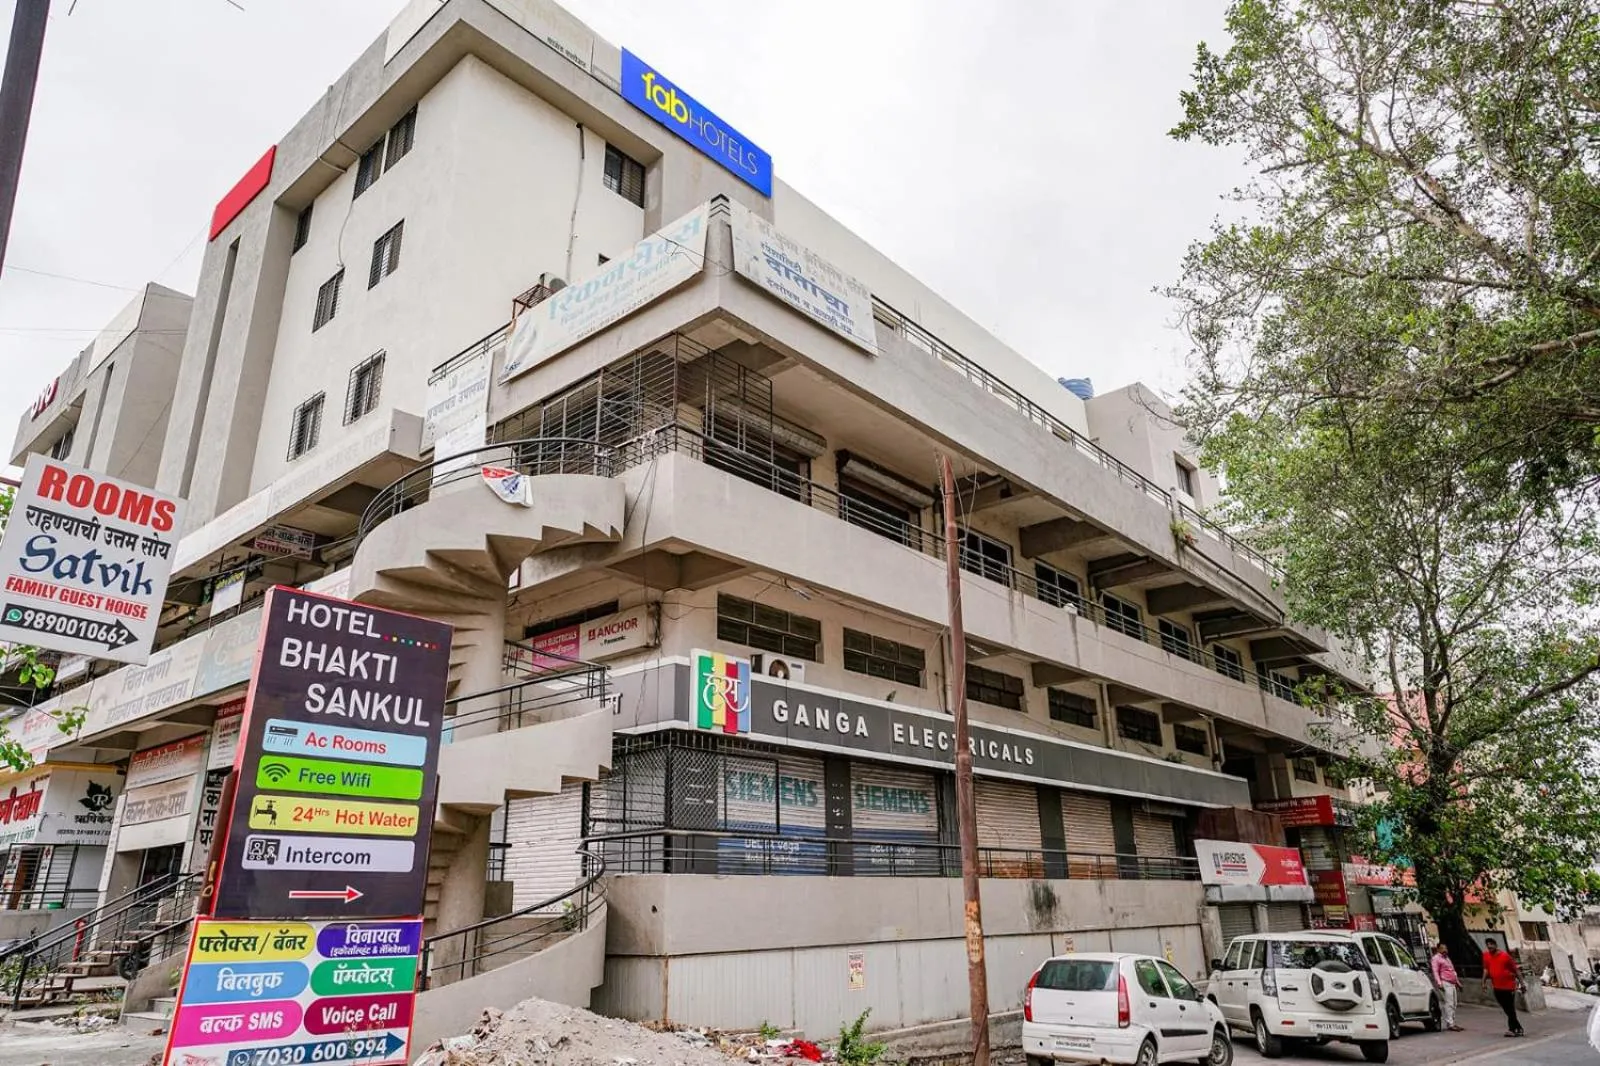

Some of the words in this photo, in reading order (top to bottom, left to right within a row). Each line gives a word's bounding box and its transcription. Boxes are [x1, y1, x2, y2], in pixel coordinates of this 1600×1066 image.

[37, 464, 176, 532] ROOMS
[26, 504, 101, 542] राहण्याची
[104, 526, 139, 552] उत्तम
[141, 532, 172, 560] सोय
[19, 535, 154, 595] Satvik
[5, 576, 58, 601] FAMILY
[59, 588, 103, 609] GUEST
[105, 598, 149, 619] HOUSE
[23, 610, 129, 645] 9890010662
[287, 598, 381, 639] HOTEL
[597, 617, 638, 638] ANCHOR
[280, 637, 398, 684] BHAKTI
[305, 683, 430, 727] SANKUL
[305, 732, 326, 748] Ac
[332, 734, 387, 754] Rooms
[772, 699, 870, 738] GANGA
[893, 722, 1035, 766] ELECRICALS
[299, 768, 336, 785] Free
[340, 769, 371, 788] Wifi
[335, 809, 364, 825] Hot
[368, 811, 415, 828] Water
[286, 846, 371, 865] Intercom
[199, 929, 257, 952] फ्लेक्स
[273, 929, 308, 951] बॅनर
[345, 925, 402, 945] विनायल
[217, 967, 284, 996] बिलबुक
[200, 1014, 245, 1034] बल्क
[248, 1011, 284, 1030] SMS
[321, 1007, 362, 1025] Voice
[368, 1003, 397, 1021] Call
[255, 1048, 305, 1066] 7030
[311, 1043, 347, 1061] 600
[353, 1038, 387, 1056] 994
